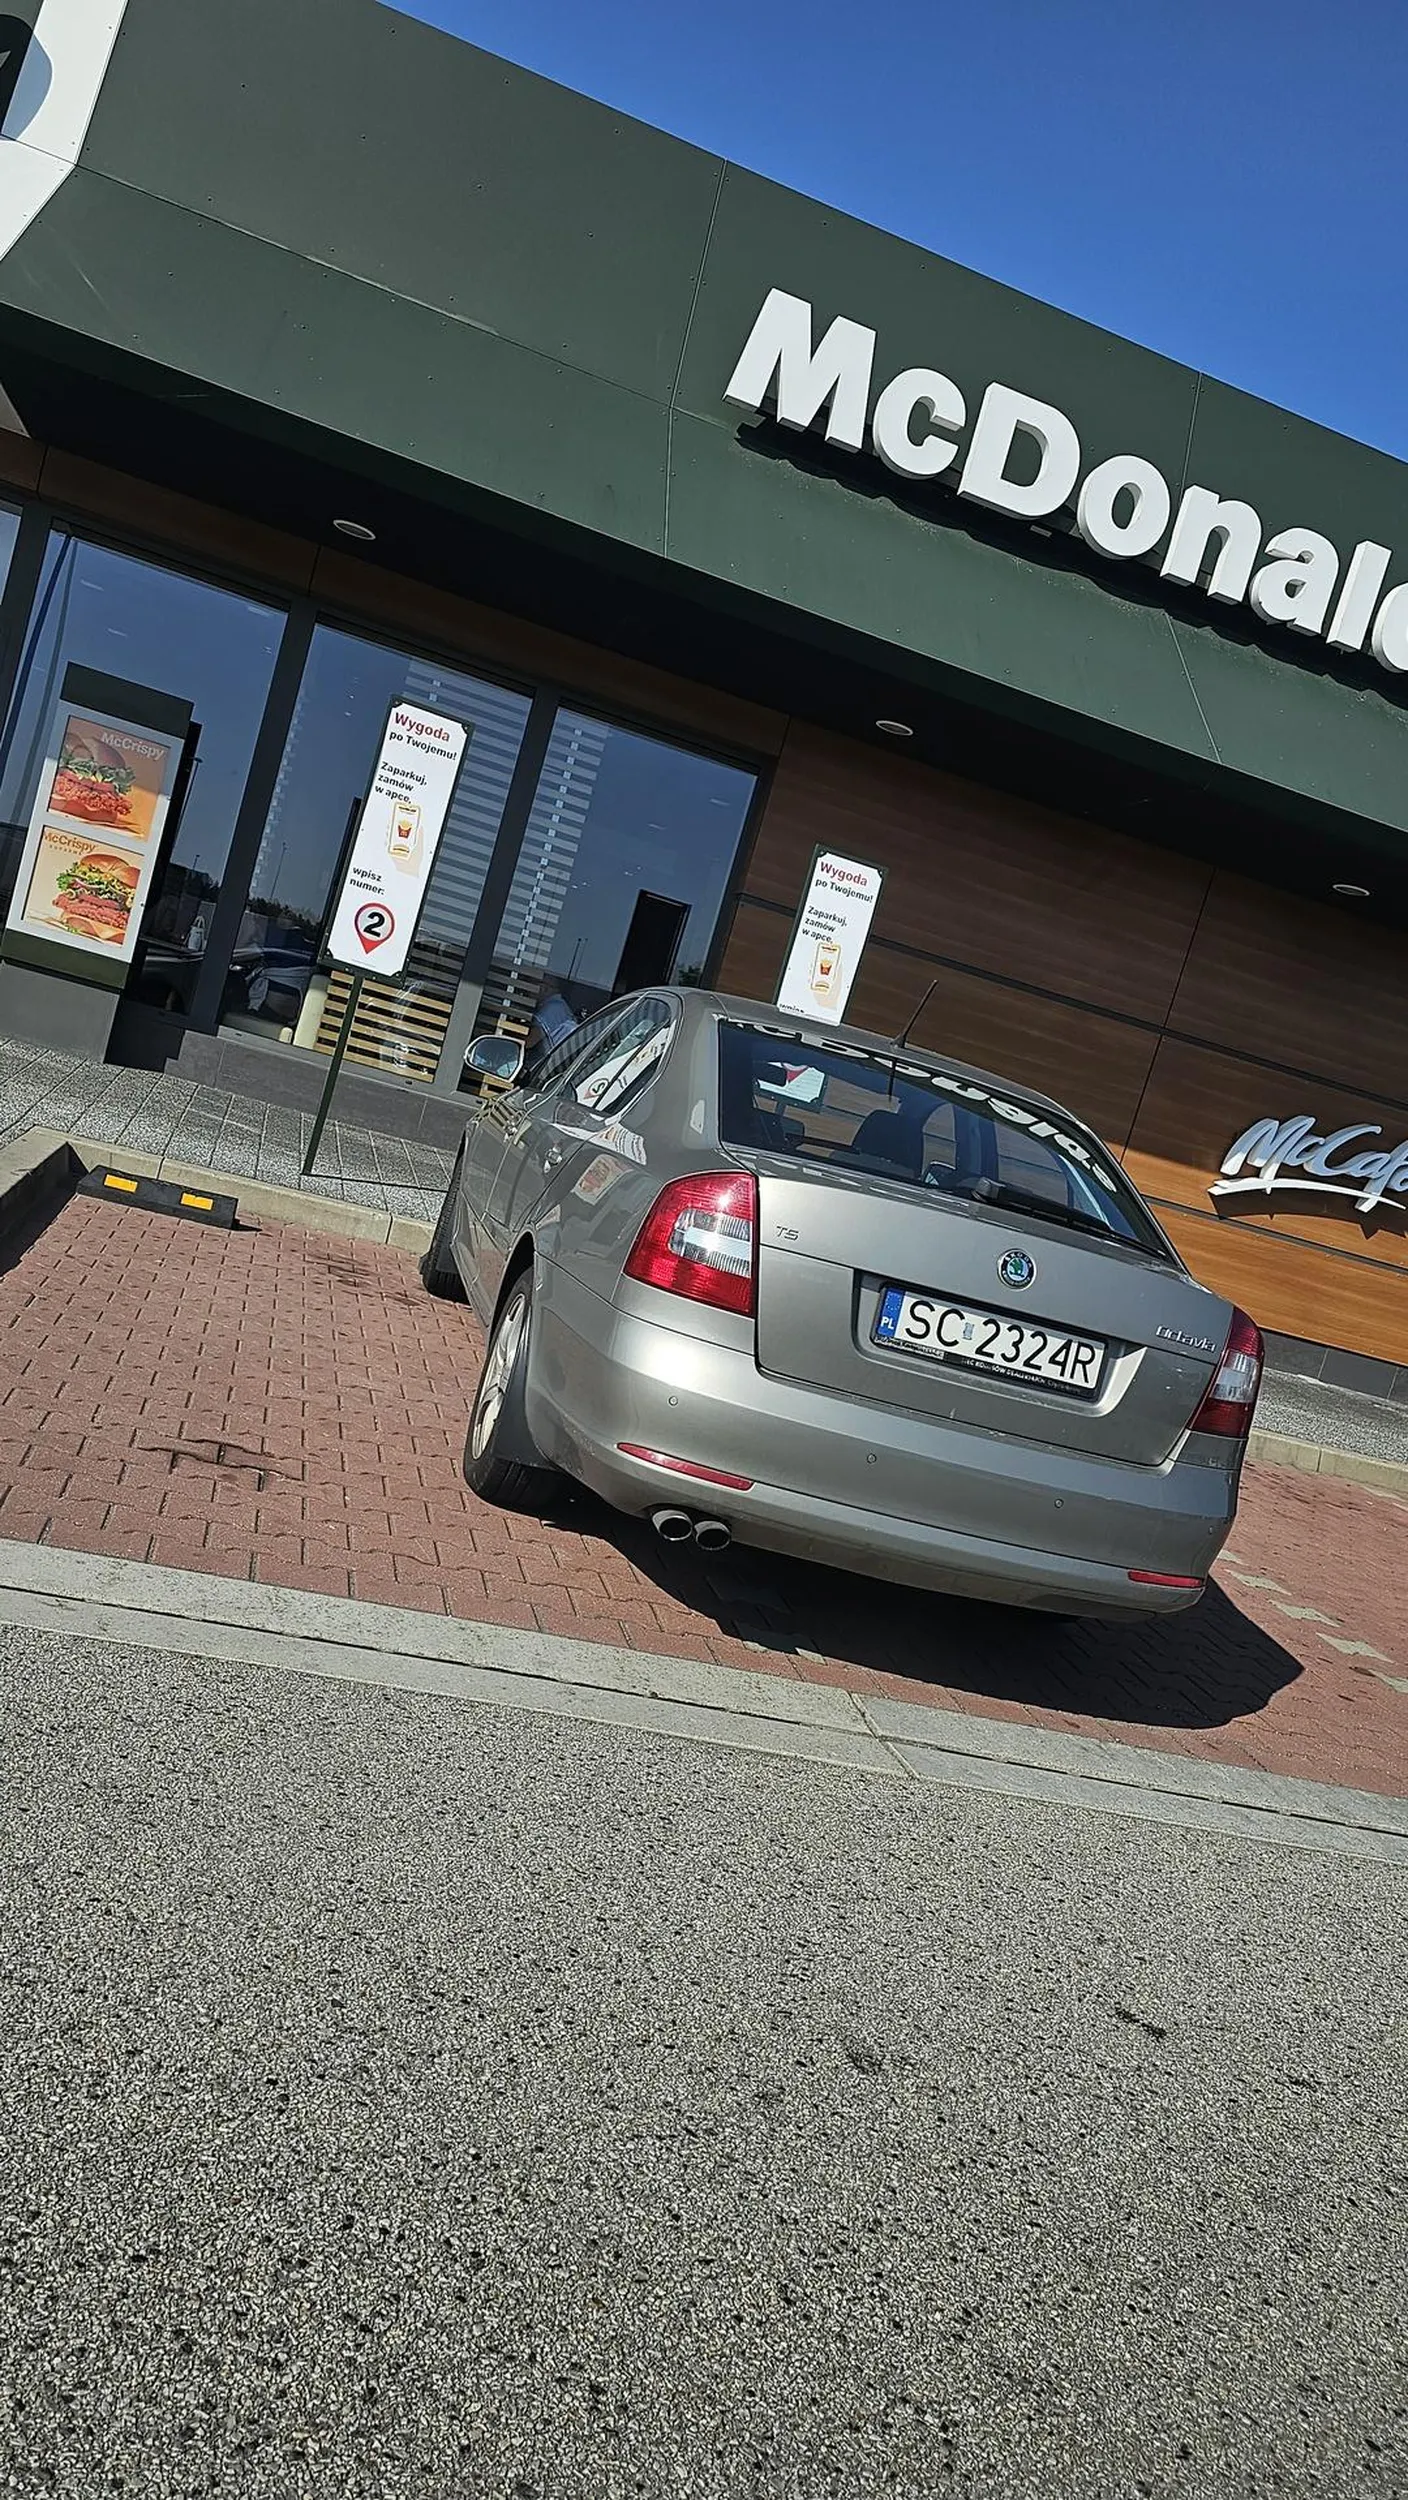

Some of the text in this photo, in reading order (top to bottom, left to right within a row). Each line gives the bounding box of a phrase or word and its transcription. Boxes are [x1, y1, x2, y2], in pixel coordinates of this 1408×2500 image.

[395, 712, 450, 742] Wygoda
[101, 732, 165, 761] McCrispy
[389, 731, 457, 760] po Twojemu!
[378, 774, 414, 792] zamów
[381, 761, 427, 786] Zaparkuj,
[375, 786, 412, 804] w apce,
[350, 877, 385, 895] numer:
[353, 867, 382, 882] wpisz
[820, 861, 868, 887] Wygoda
[815, 879, 874, 903] po Twojemu!
[363, 911, 386, 938] 2
[802, 928, 809, 936] w
[804, 918, 836, 933] zamów
[880, 1316, 895, 1330] PL
[905, 1300, 966, 1347] SC
[974, 1318, 1097, 1384] 2324R
